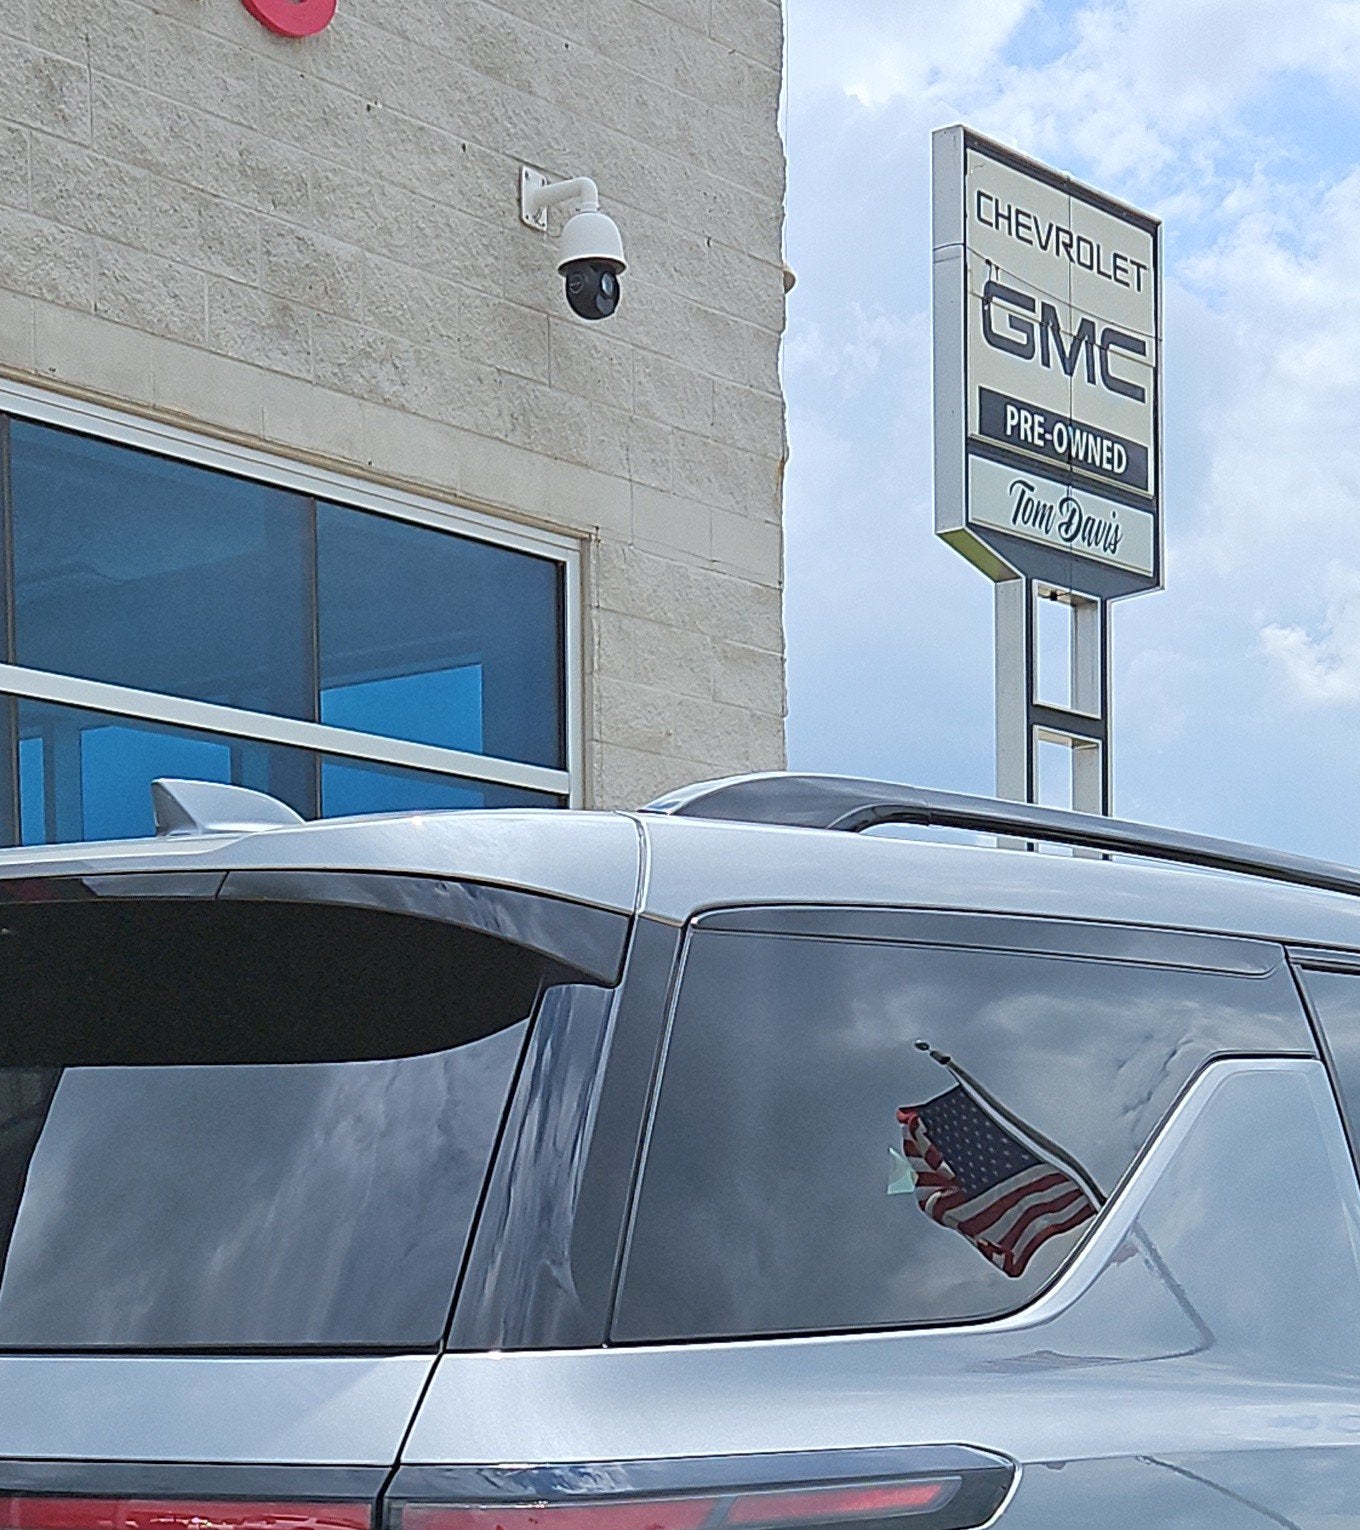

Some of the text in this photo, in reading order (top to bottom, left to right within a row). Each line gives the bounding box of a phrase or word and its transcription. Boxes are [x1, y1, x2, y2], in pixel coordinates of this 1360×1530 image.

[976, 189, 1147, 292] CHEVROLET
[981, 280, 1146, 404] GMC
[1005, 404, 1127, 476] PRE-OWNED
[1009, 479, 1123, 555] Tom Davis
